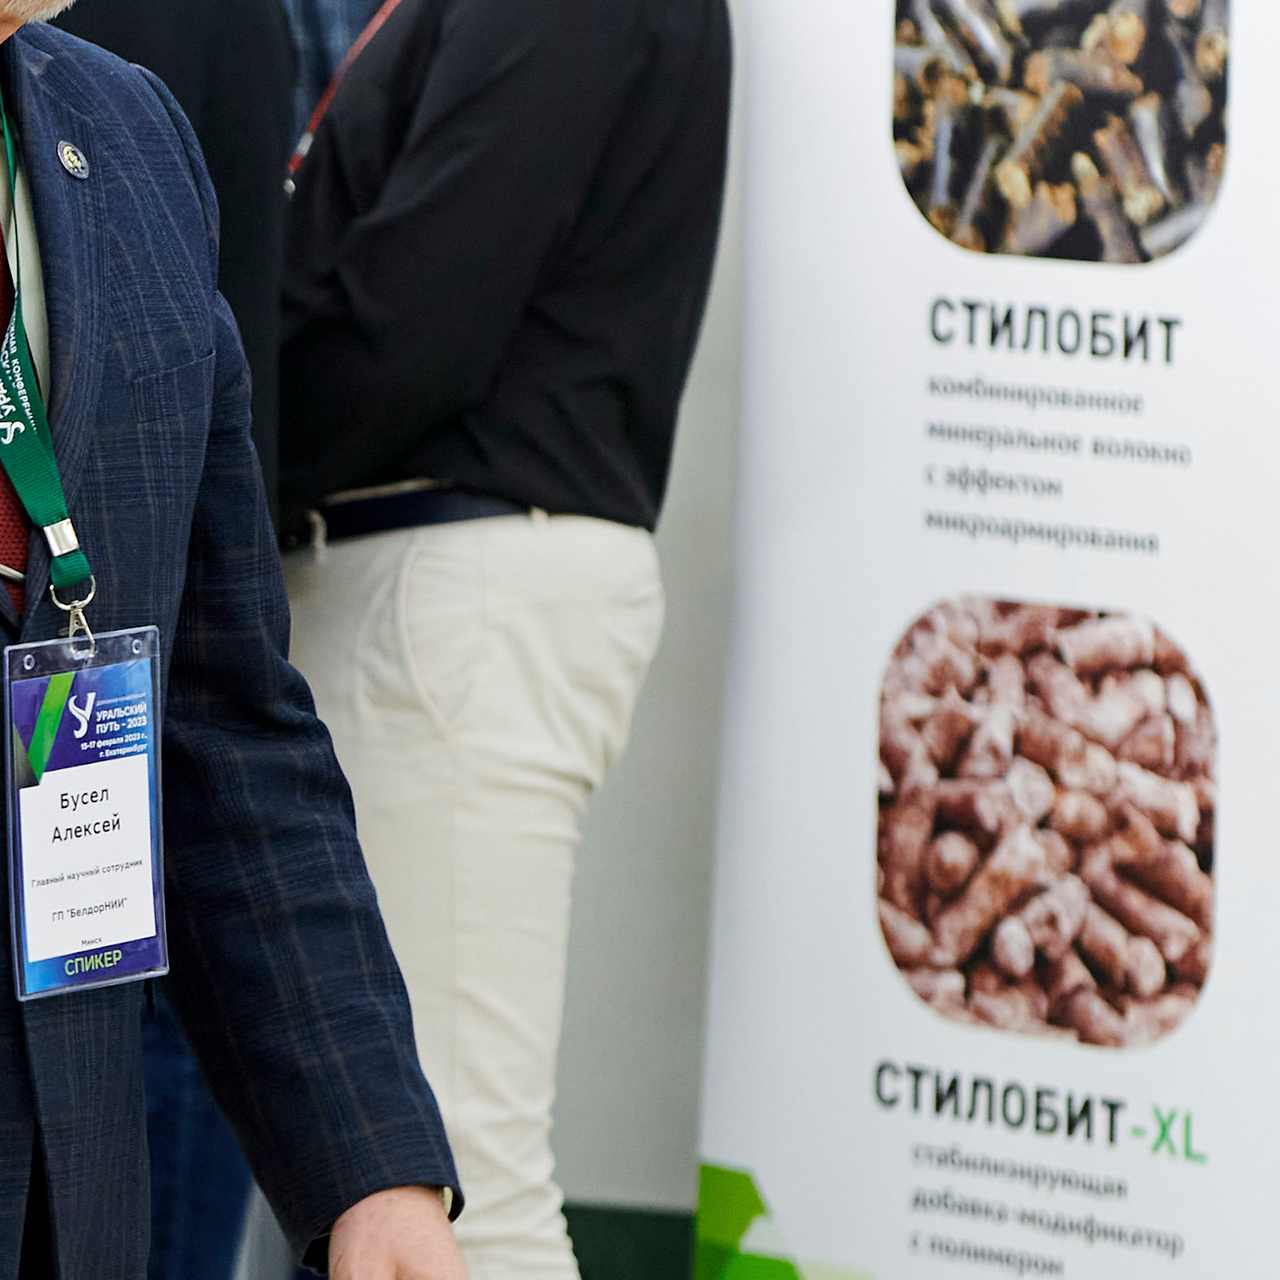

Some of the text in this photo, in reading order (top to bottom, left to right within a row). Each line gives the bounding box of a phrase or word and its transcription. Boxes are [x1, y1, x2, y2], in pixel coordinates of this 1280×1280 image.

[929, 296, 1183, 365] СТИЛОБИТ
[928, 373, 1145, 415] комбинированное
[927, 421, 1192, 467] минеральное волокно
[945, 465, 1064, 498] эффектом
[96, 702, 147, 722] УРАЛЬСКИЙ
[96, 721, 121, 735] ПУТЬ
[127, 715, 147, 729] 2023
[60, 788, 109, 812] Бусел
[51, 812, 121, 844] Алексей
[31, 859, 144, 888] Главный научный сотрудник
[52, 910, 65, 923] ГП
[64, 949, 123, 976] СПИКЕР
